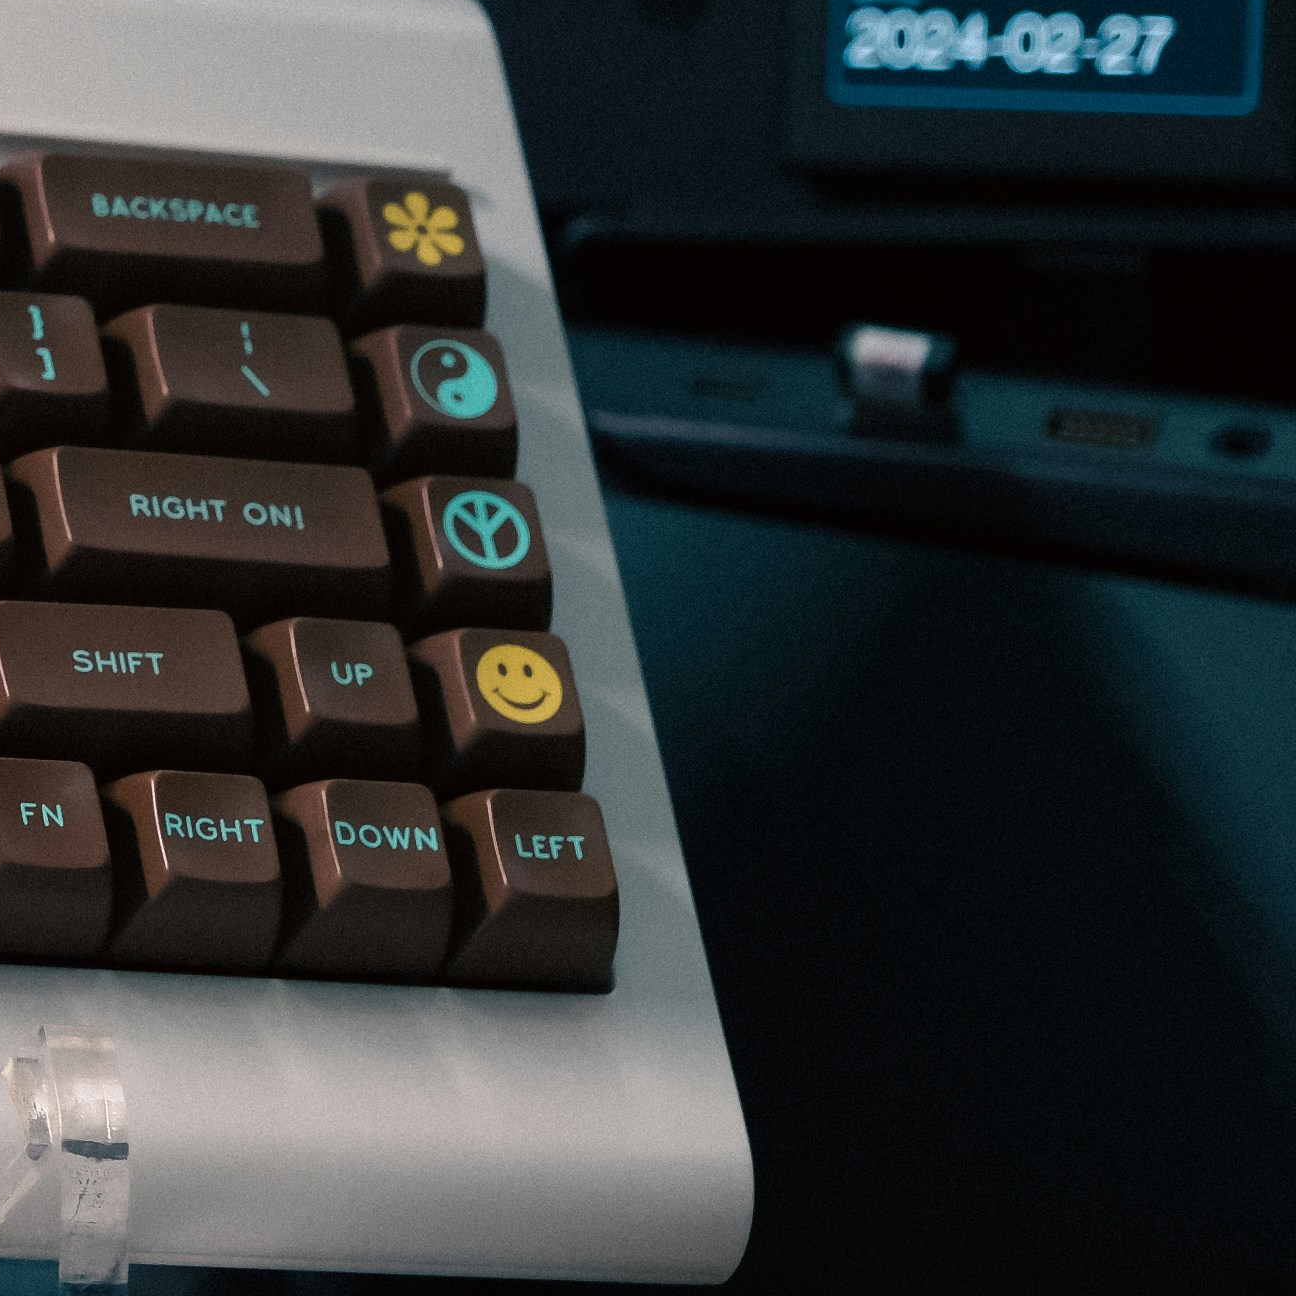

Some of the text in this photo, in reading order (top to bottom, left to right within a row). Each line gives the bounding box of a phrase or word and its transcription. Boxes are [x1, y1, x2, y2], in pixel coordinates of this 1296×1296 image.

[844, 7, 1176, 75] 2024-02-27
[91, 194, 260, 229] BACKSPACE
[130, 494, 304, 529] RIGHT ON!
[73, 650, 162, 674] SHIFT
[331, 663, 373, 685] UP
[20, 803, 64, 826] FN
[165, 813, 264, 843] RIGHT
[335, 820, 439, 852] DOWN
[515, 835, 584, 859] LEFT
